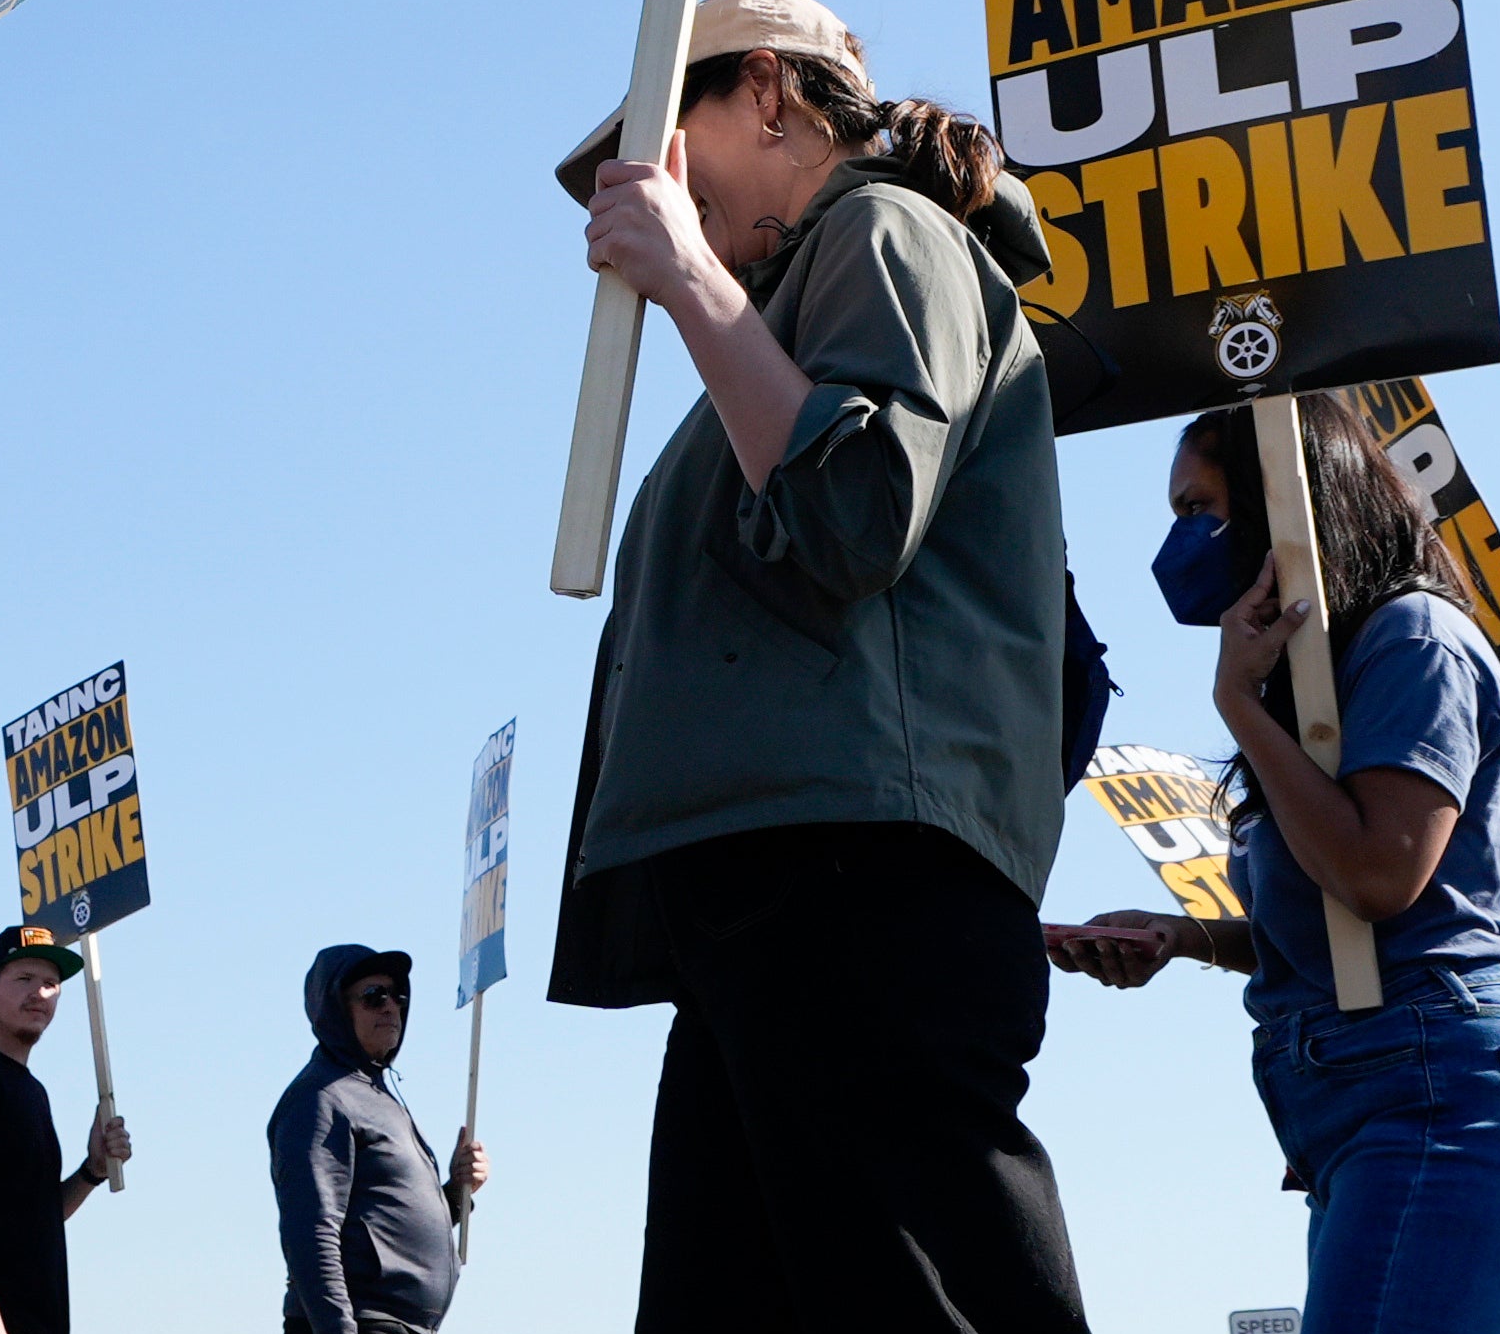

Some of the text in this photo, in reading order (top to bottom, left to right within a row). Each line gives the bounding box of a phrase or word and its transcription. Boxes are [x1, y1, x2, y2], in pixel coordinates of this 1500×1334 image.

[6, 667, 121, 753] TANNC
[15, 699, 128, 807] AMAZON
[13, 754, 135, 849] ULP
[1122, 818, 1230, 863] UL
[20, 794, 144, 916] STRIKE
[1237, 1318, 1295, 1334] SPEED
